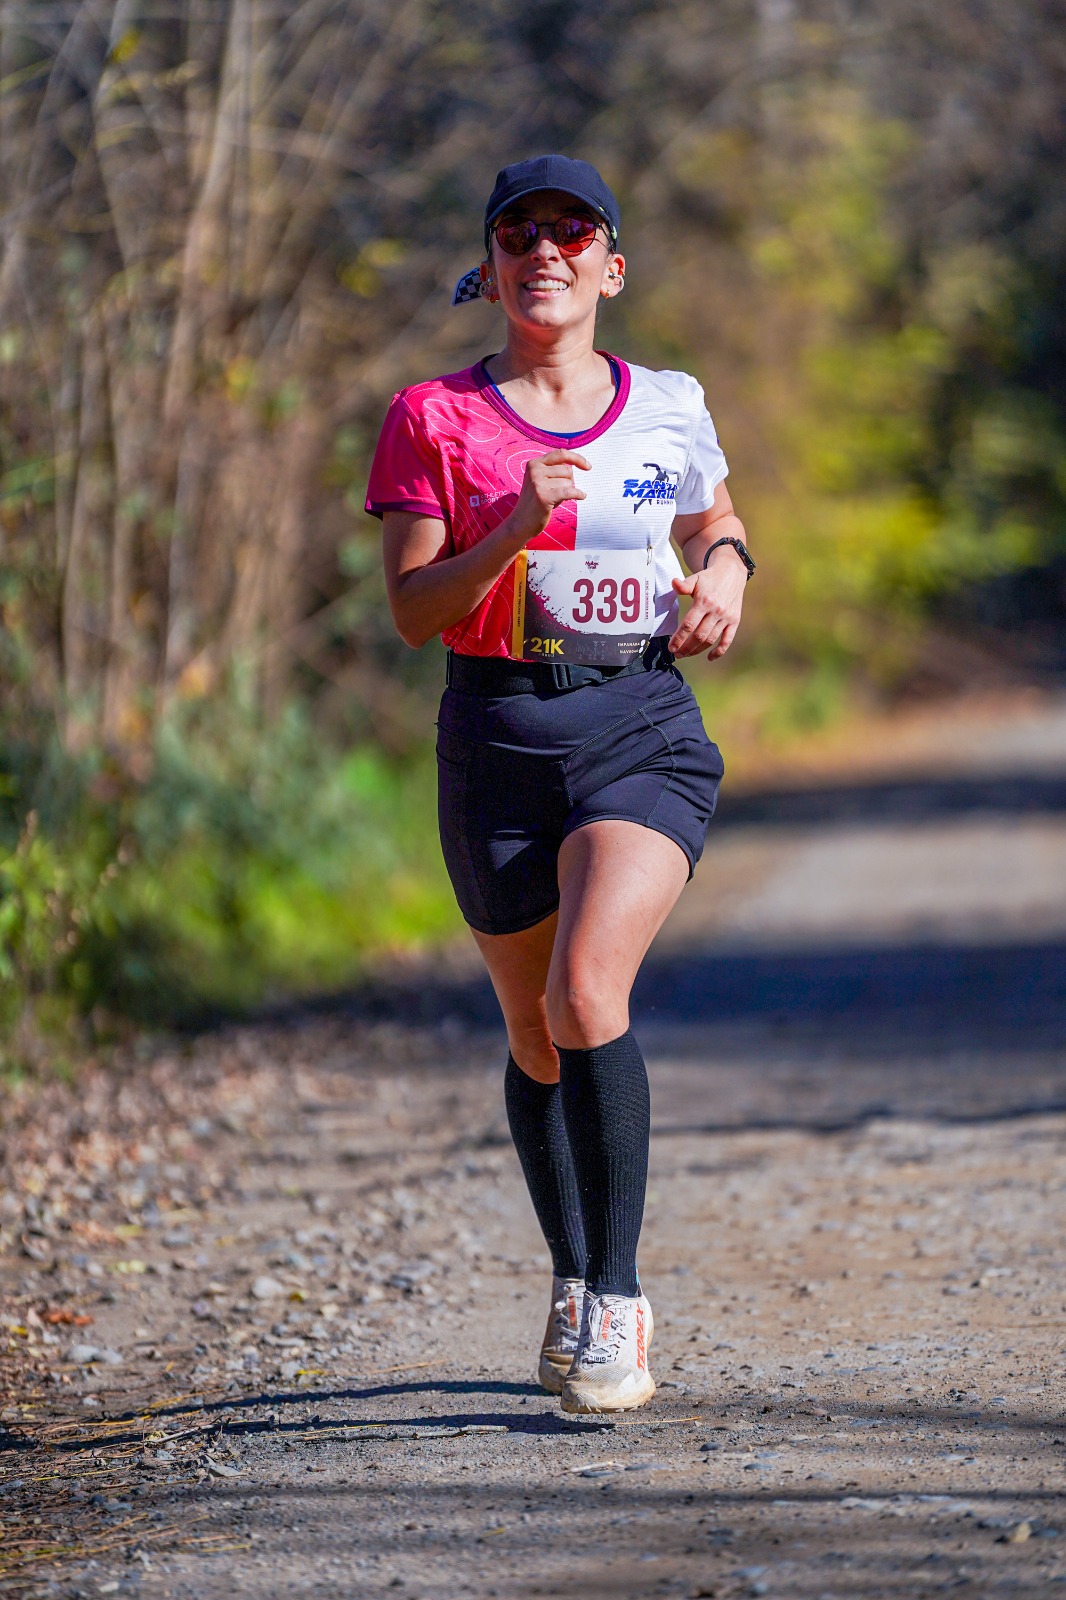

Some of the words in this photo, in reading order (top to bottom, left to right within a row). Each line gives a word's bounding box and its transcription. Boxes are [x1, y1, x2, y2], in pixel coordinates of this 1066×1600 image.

[622, 488, 675, 499] MARIA
[572, 578, 640, 624] 339
[530, 636, 564, 655] 21K
[602, 1311, 613, 1333] TERRE
[636, 1302, 645, 1370] TERREX
